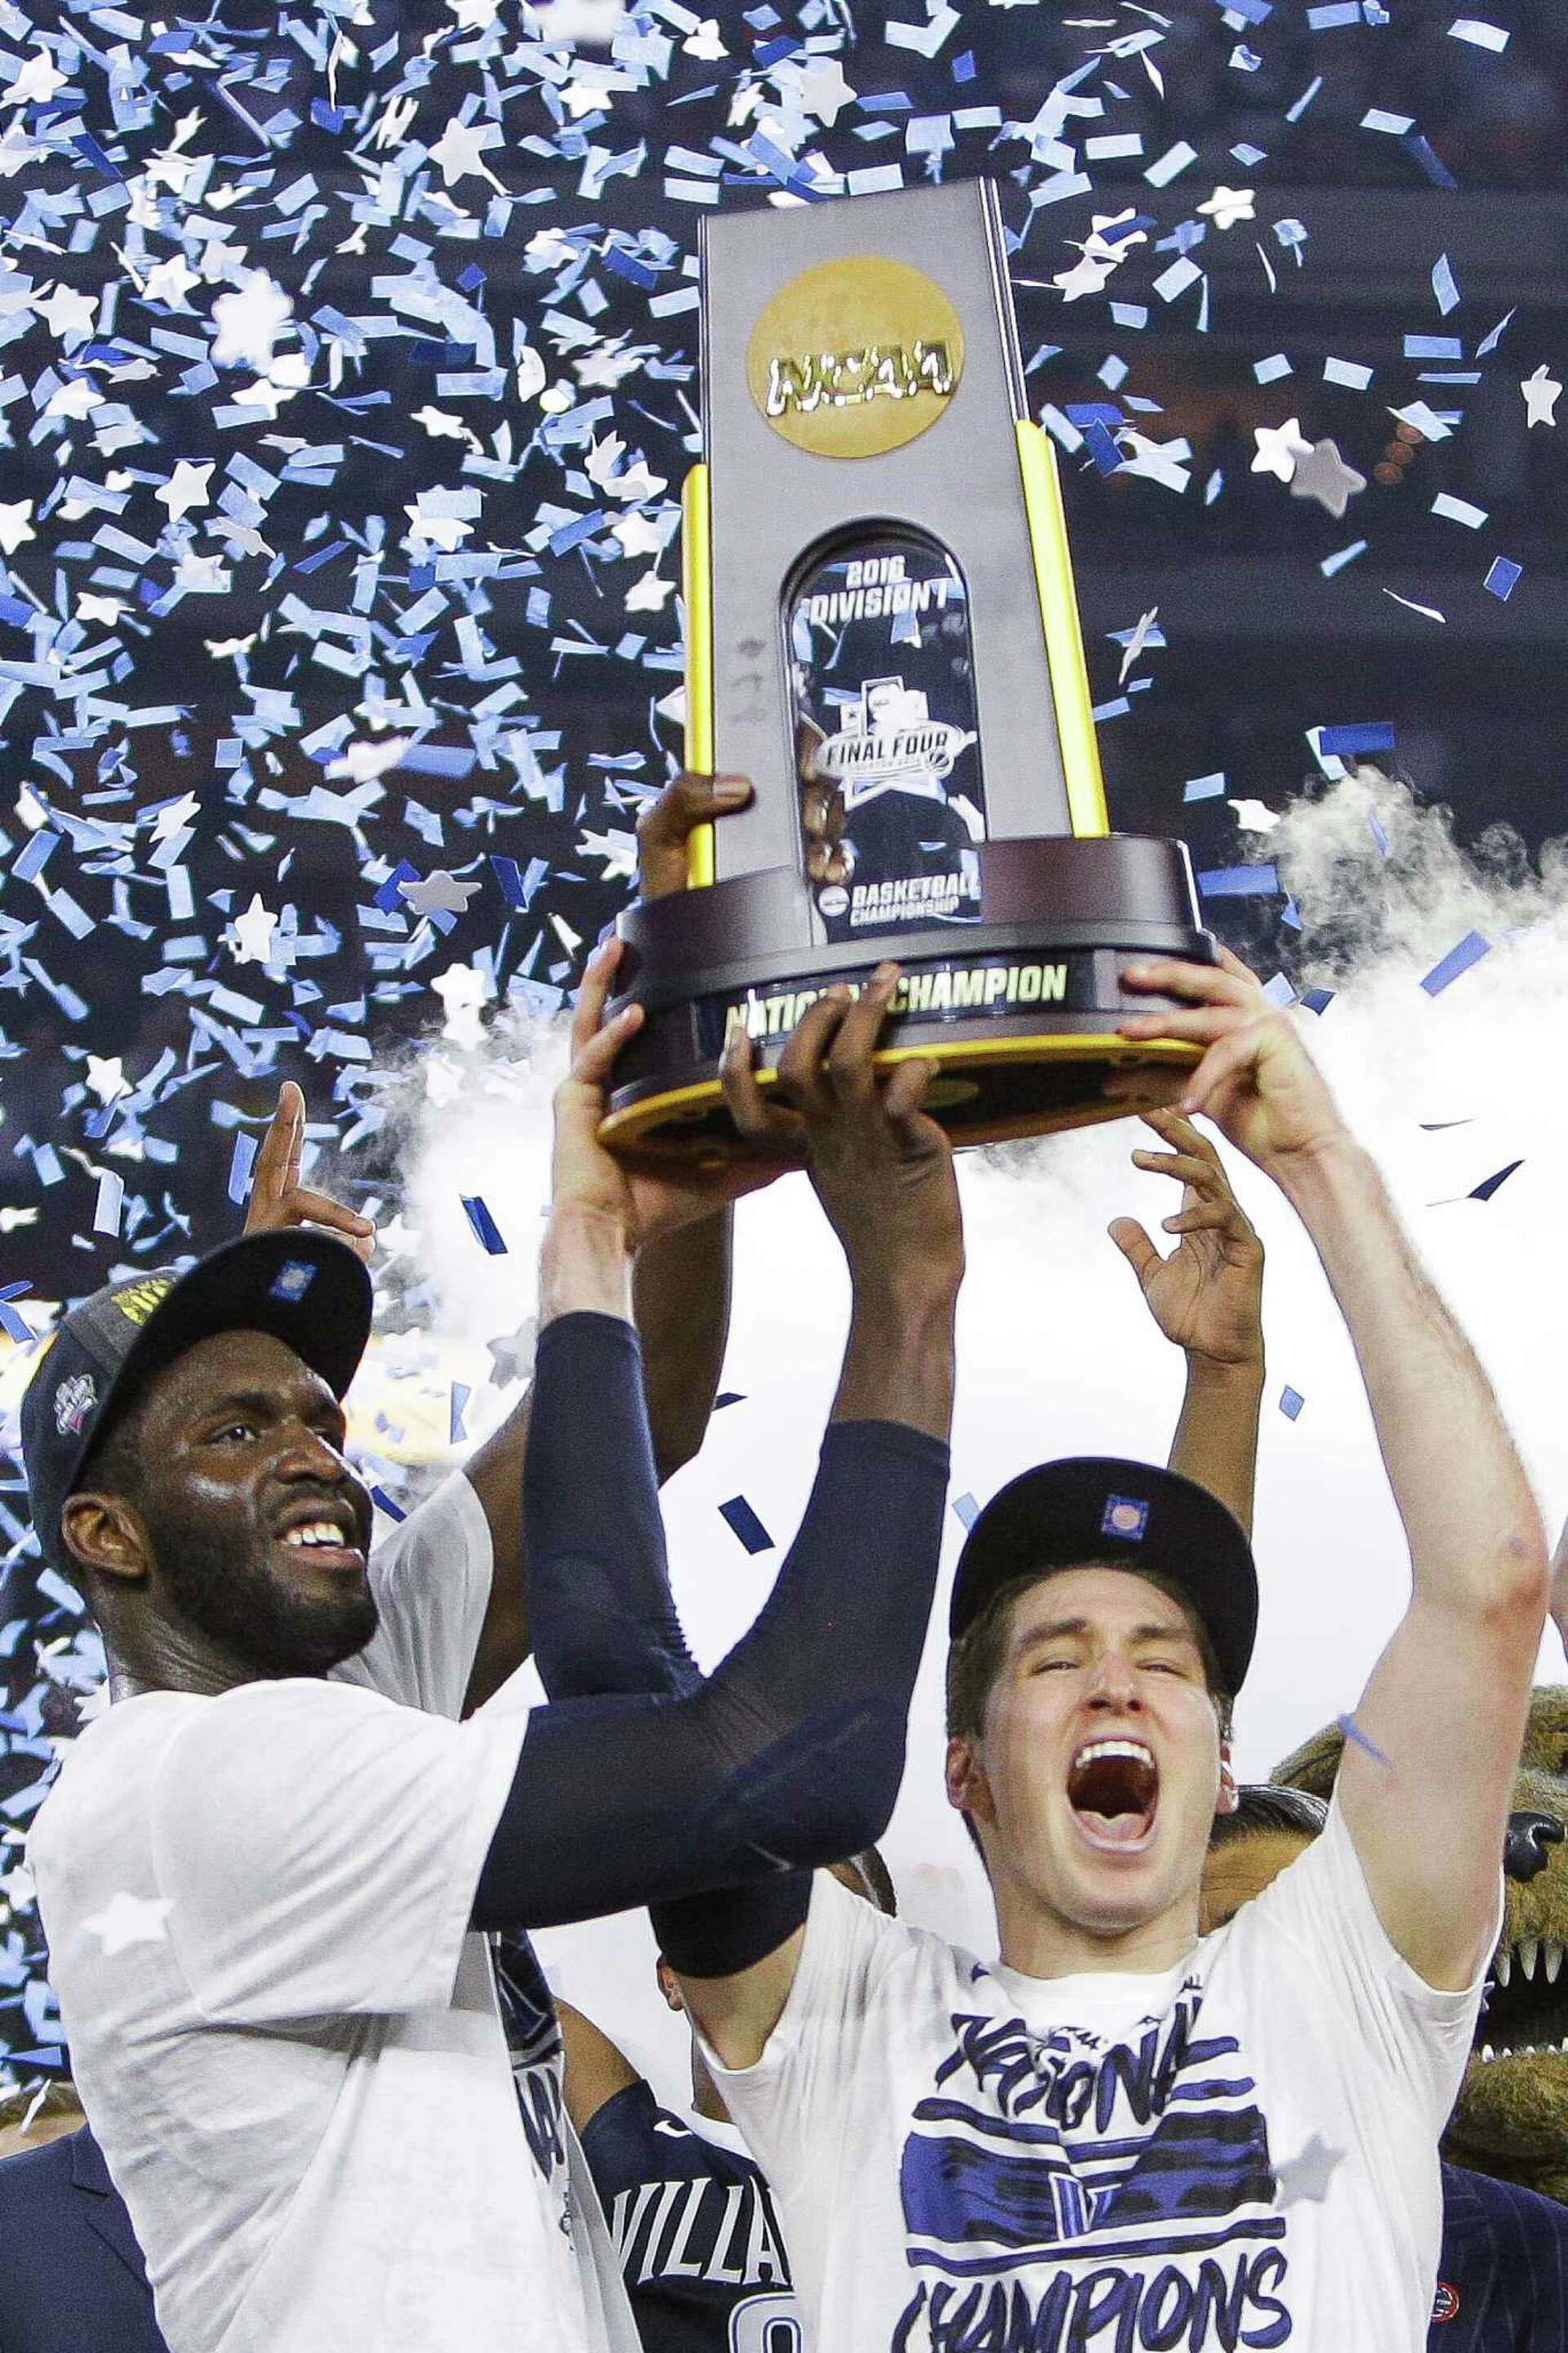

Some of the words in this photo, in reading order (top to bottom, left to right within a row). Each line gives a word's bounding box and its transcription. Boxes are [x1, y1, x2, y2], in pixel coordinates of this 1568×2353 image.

[766, 340, 953, 417] NCAA
[846, 555, 906, 589] 2016
[810, 582, 931, 626] DIVISION
[827, 738, 884, 765] FINAL
[893, 732, 948, 757] FOUR
[852, 871, 981, 909] BASKETBALL
[887, 965, 1068, 1014] CHAMPION
[892, 2247, 1293, 2353] CHAMPIONS
